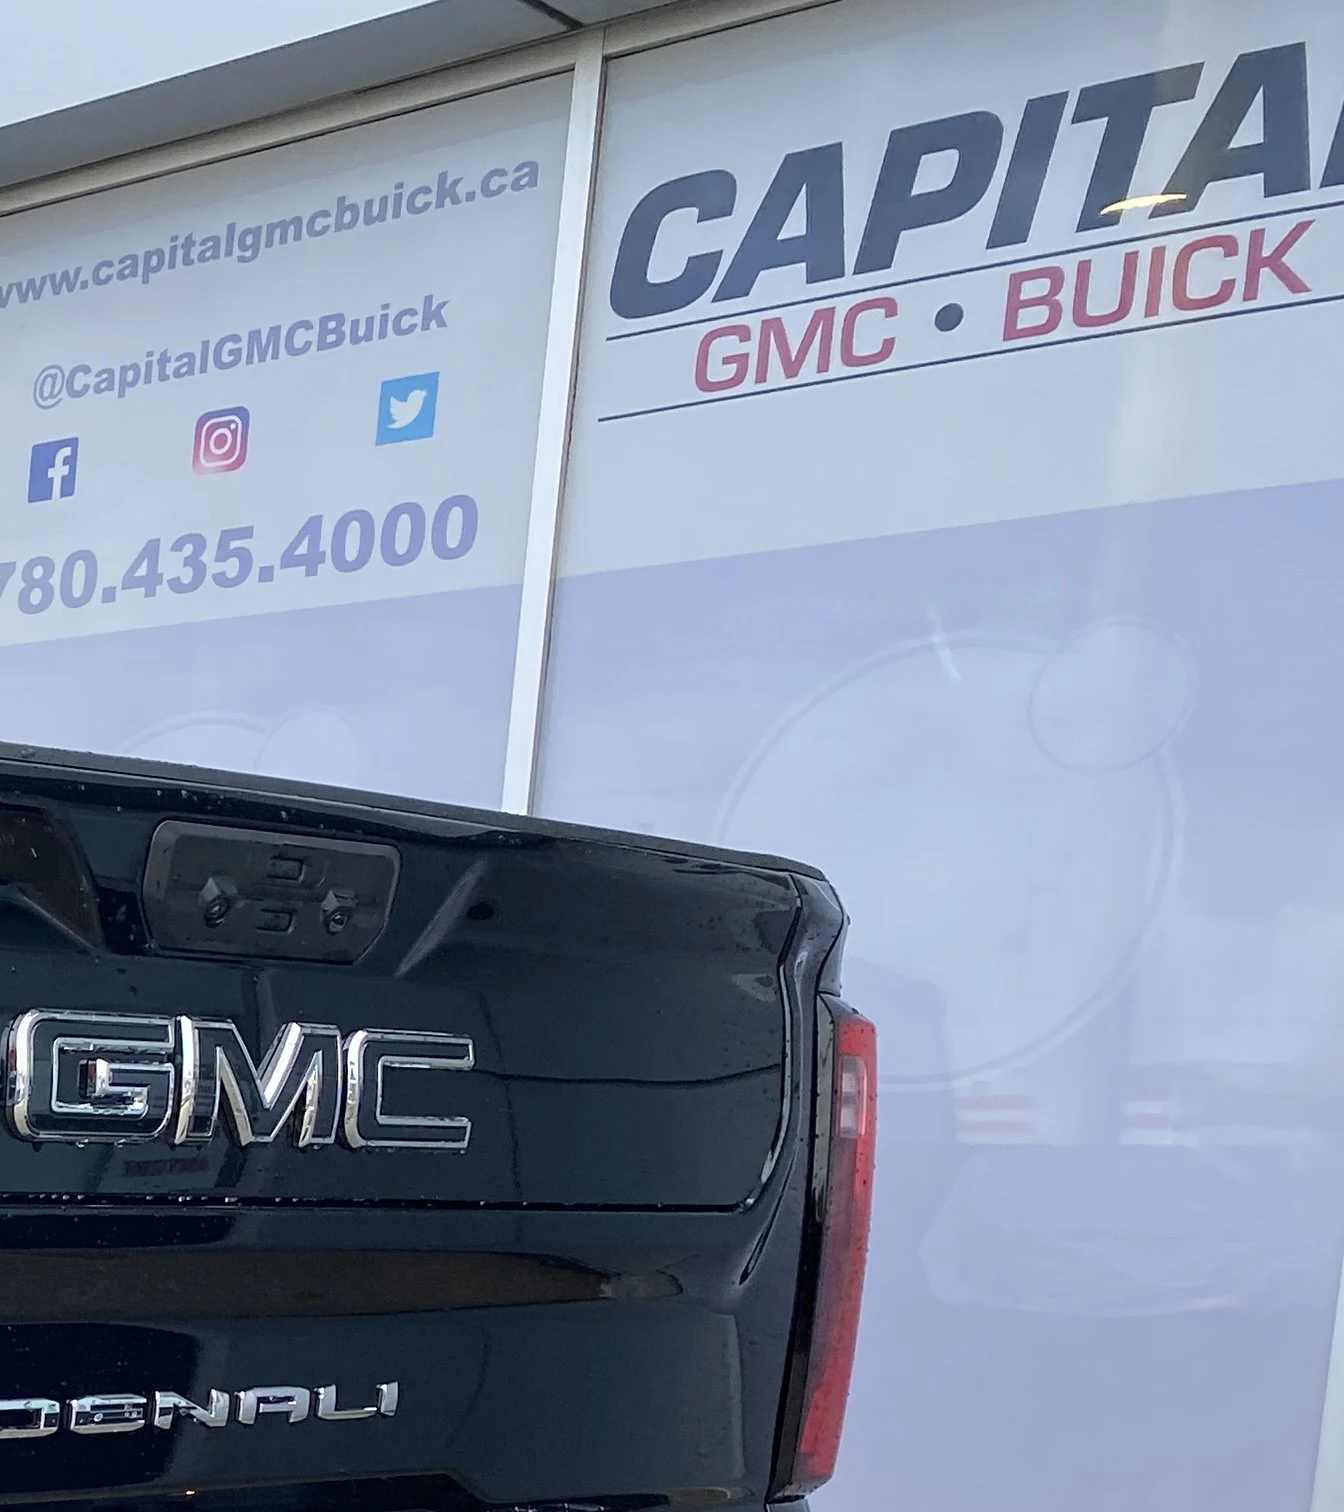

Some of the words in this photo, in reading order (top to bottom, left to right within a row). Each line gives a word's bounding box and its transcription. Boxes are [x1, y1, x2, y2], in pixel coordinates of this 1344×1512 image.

[609, 41, 1344, 320] CAPITA
[33, 294, 450, 410] @CapitalGMCBuick
[694, 297, 899, 393] GMC
[1002, 219, 1315, 342] BUICK
[0, 1008, 474, 1150] GMC
